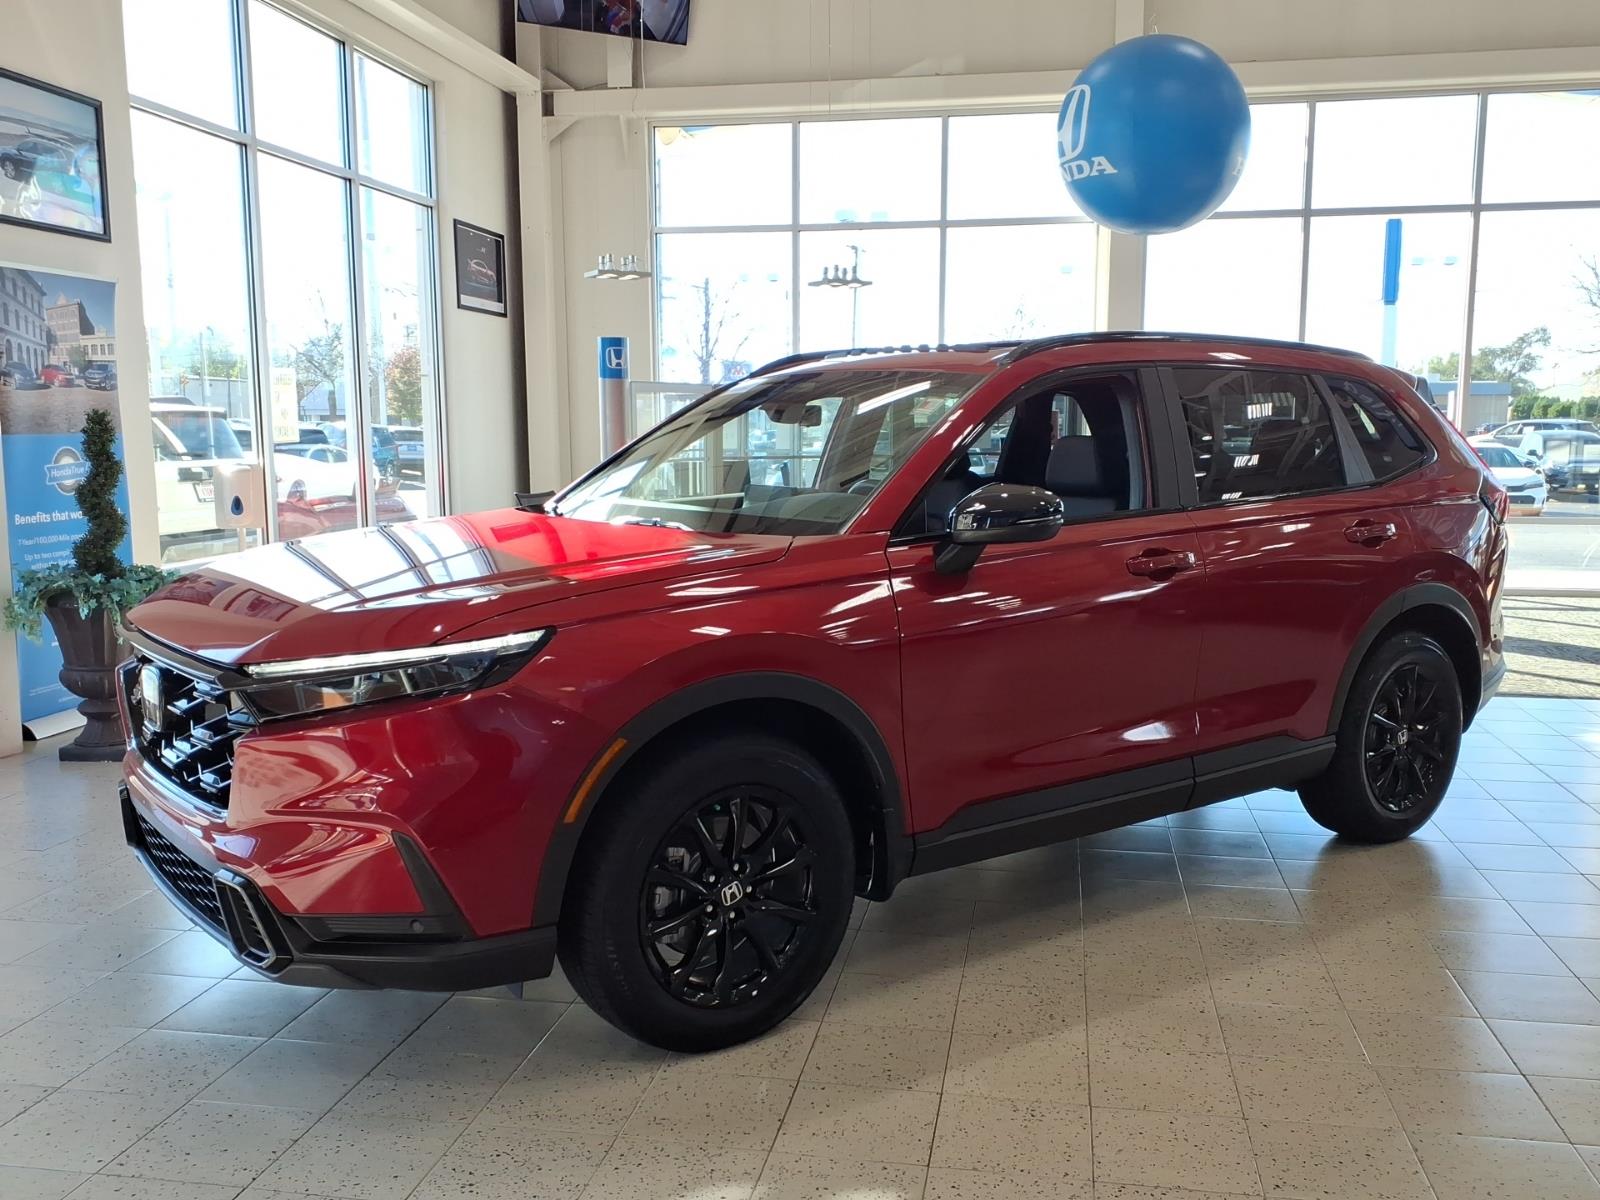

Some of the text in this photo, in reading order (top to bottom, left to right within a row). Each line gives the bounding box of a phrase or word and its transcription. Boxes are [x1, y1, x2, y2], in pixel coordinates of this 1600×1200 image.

[1060, 156, 1118, 182] NDA
[15, 510, 83, 525] Benefits that wo
